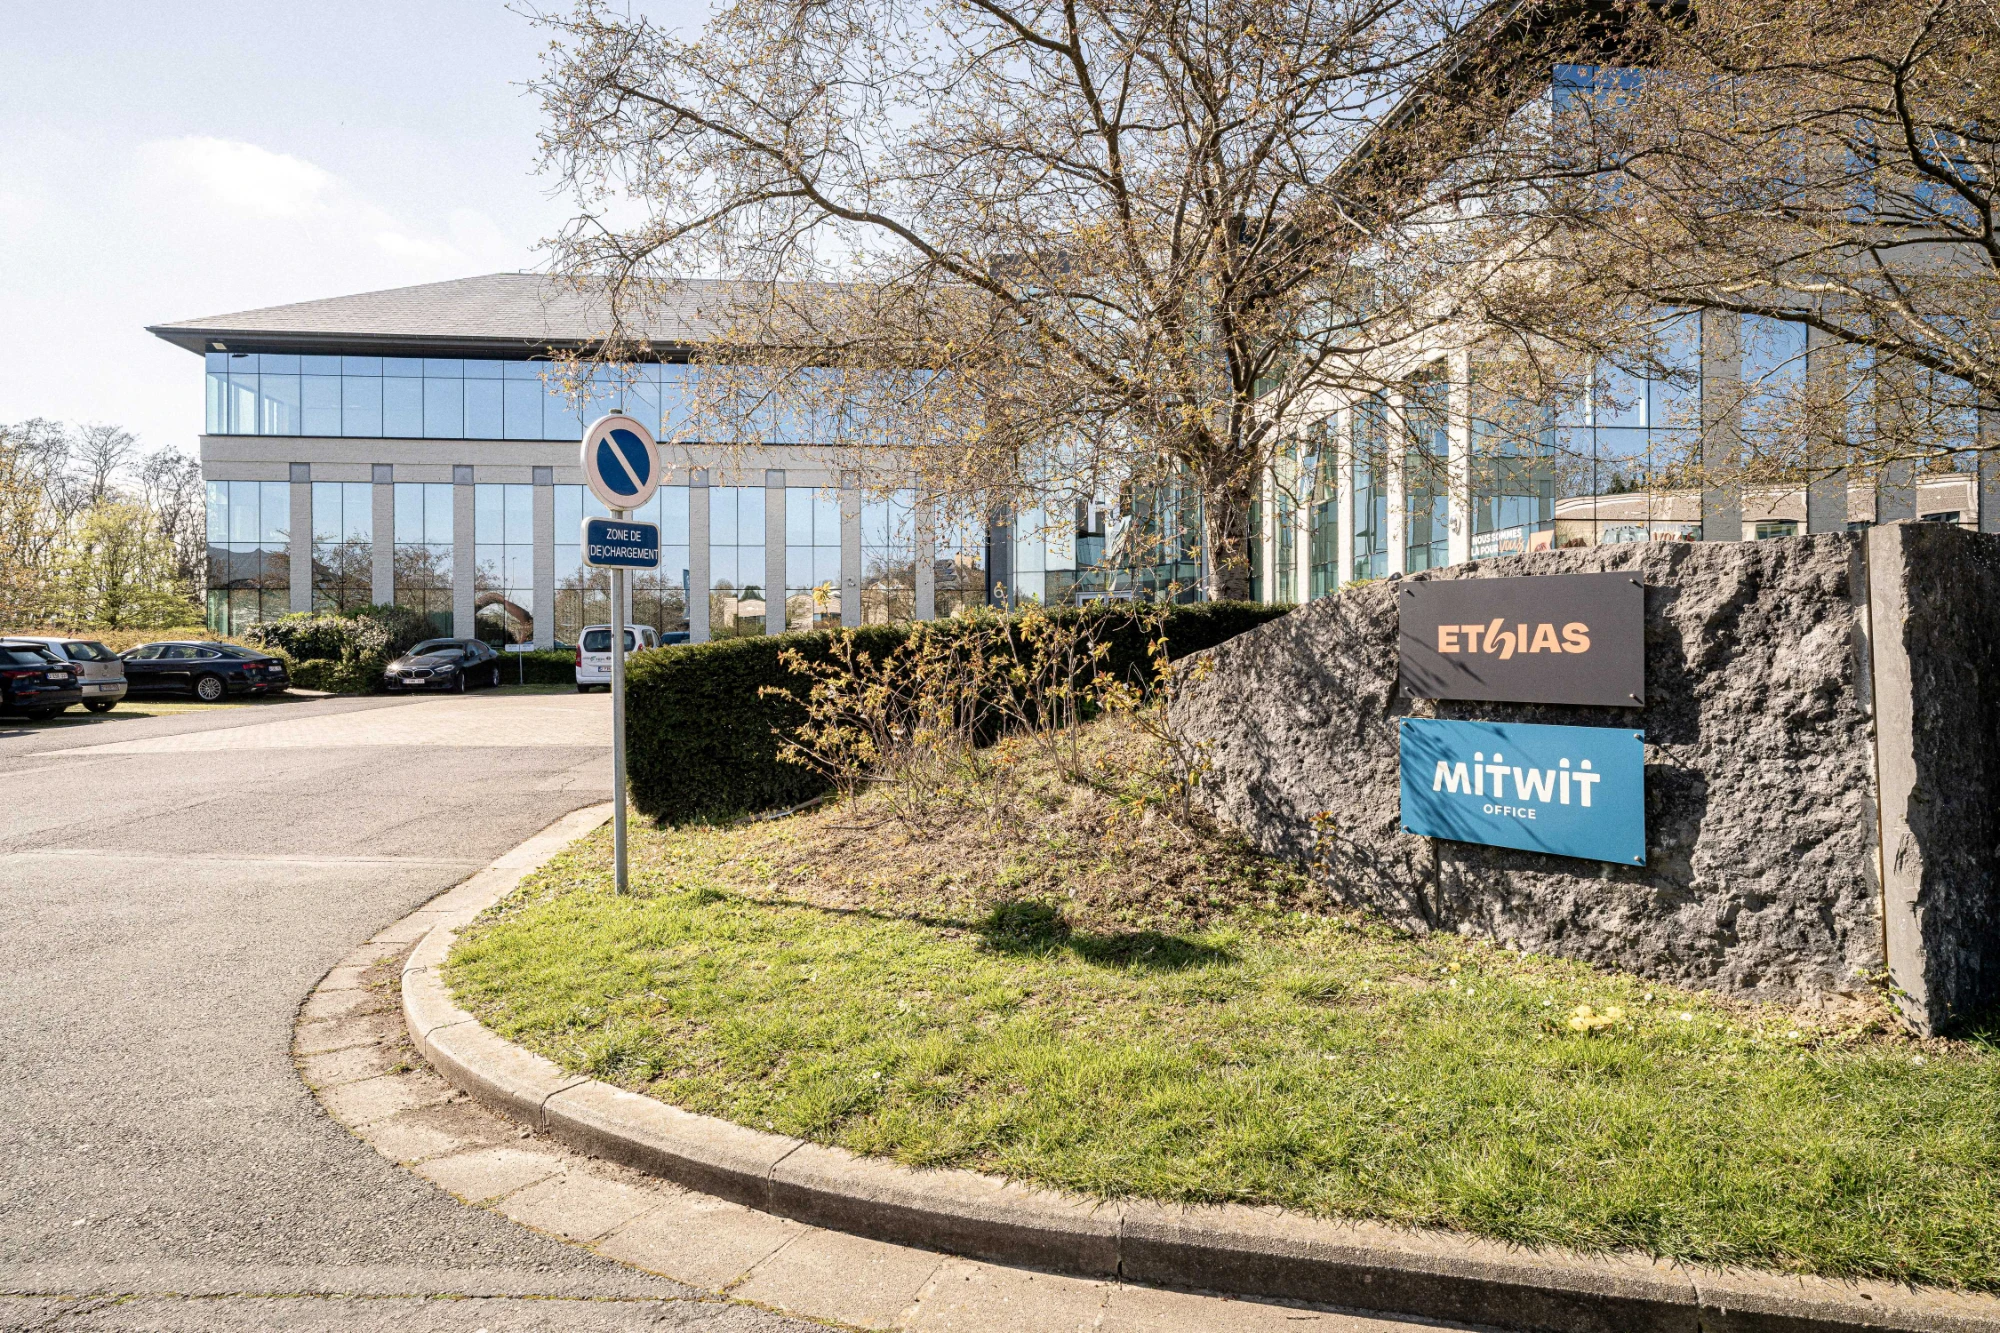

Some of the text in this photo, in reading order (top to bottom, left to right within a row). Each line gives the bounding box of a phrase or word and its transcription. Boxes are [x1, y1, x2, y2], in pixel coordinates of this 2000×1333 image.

[606, 528, 642, 542] ZONE DE
[1472, 528, 1522, 546] NOUS SOMMES
[588, 545, 659, 560] (DE)CHARGEMENT
[1480, 544, 1498, 555] POUR
[1483, 803, 1537, 820] OFFICE
